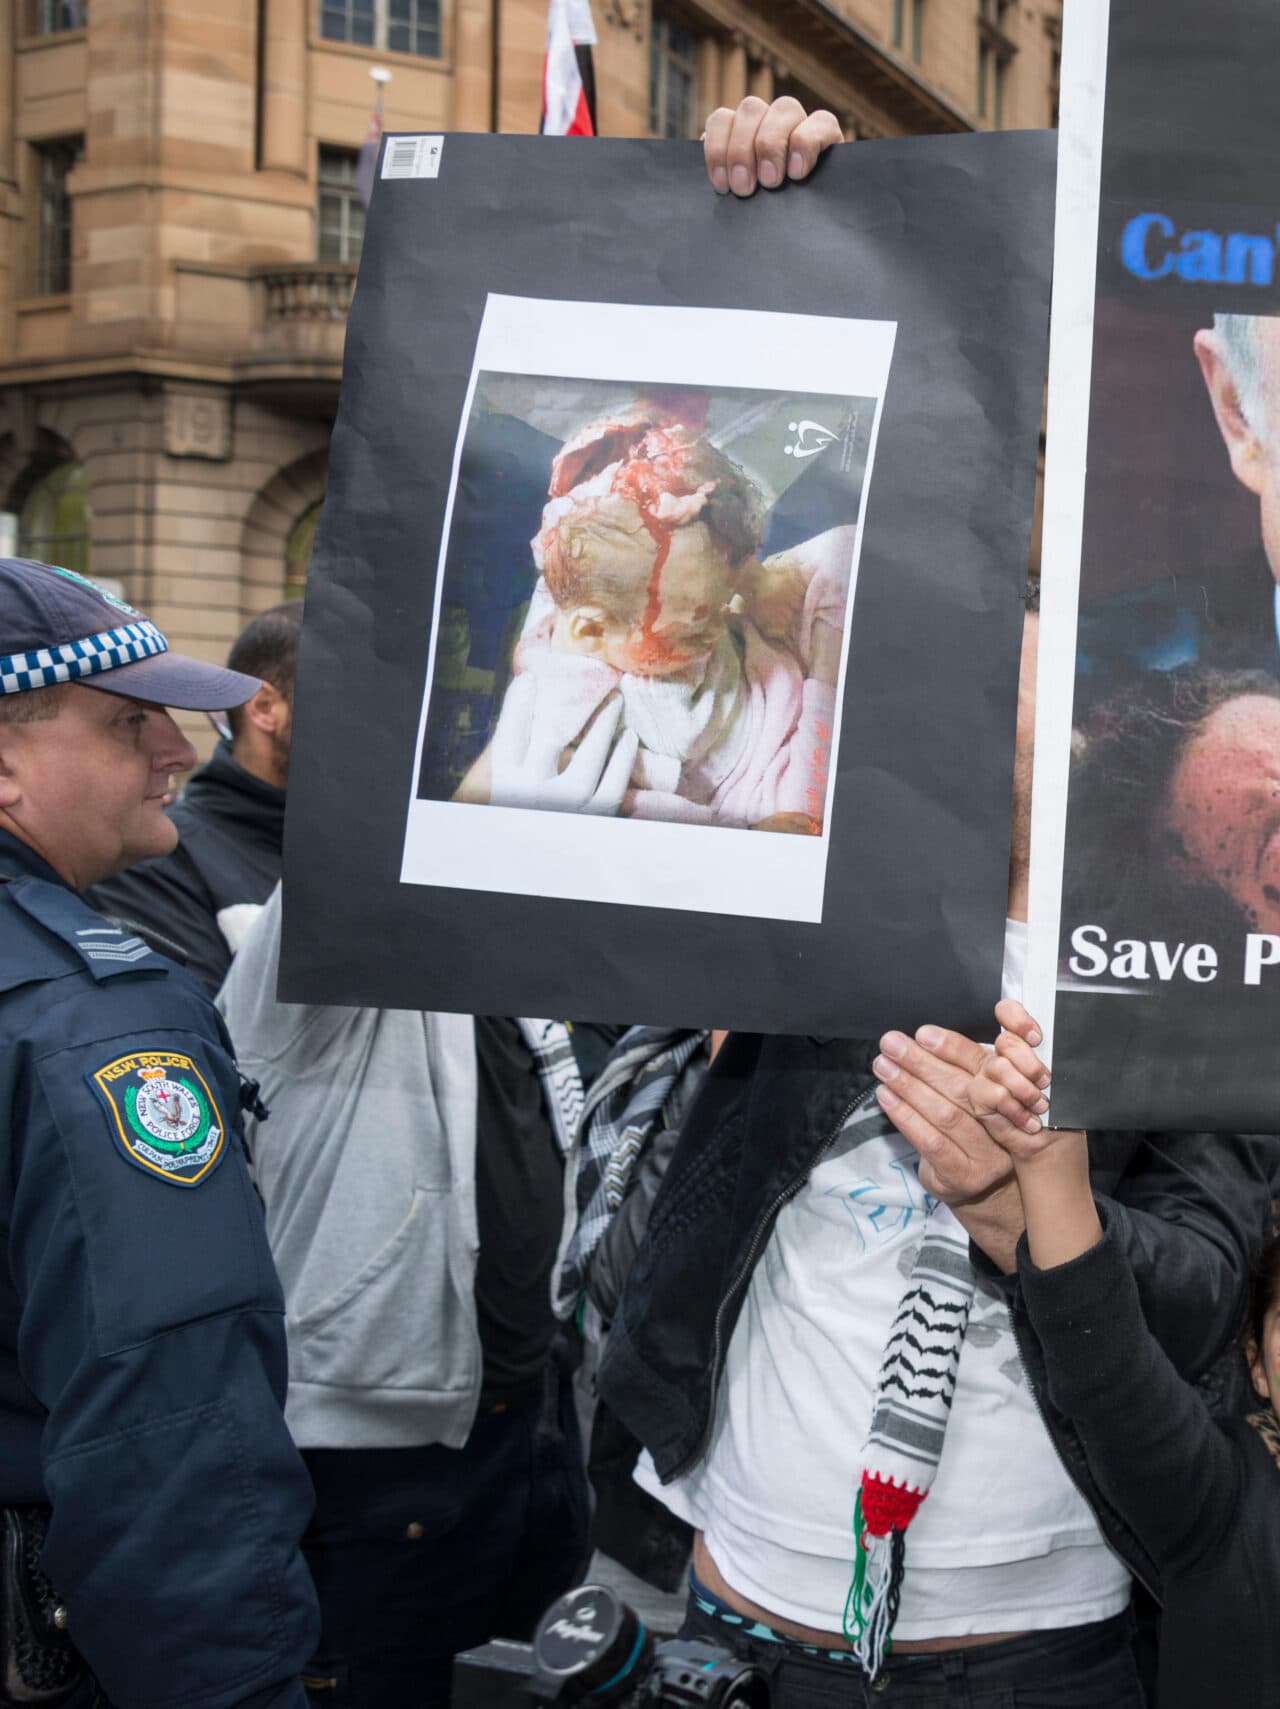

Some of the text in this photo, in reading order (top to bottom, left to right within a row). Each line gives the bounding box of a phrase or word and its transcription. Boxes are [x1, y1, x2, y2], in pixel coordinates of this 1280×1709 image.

[1069, 925, 1218, 983] Save
[140, 1056, 190, 1070] POLICE
[138, 1081, 199, 1117] NEW SOUTH WALES
[146, 1120, 180, 1141] POLICE
